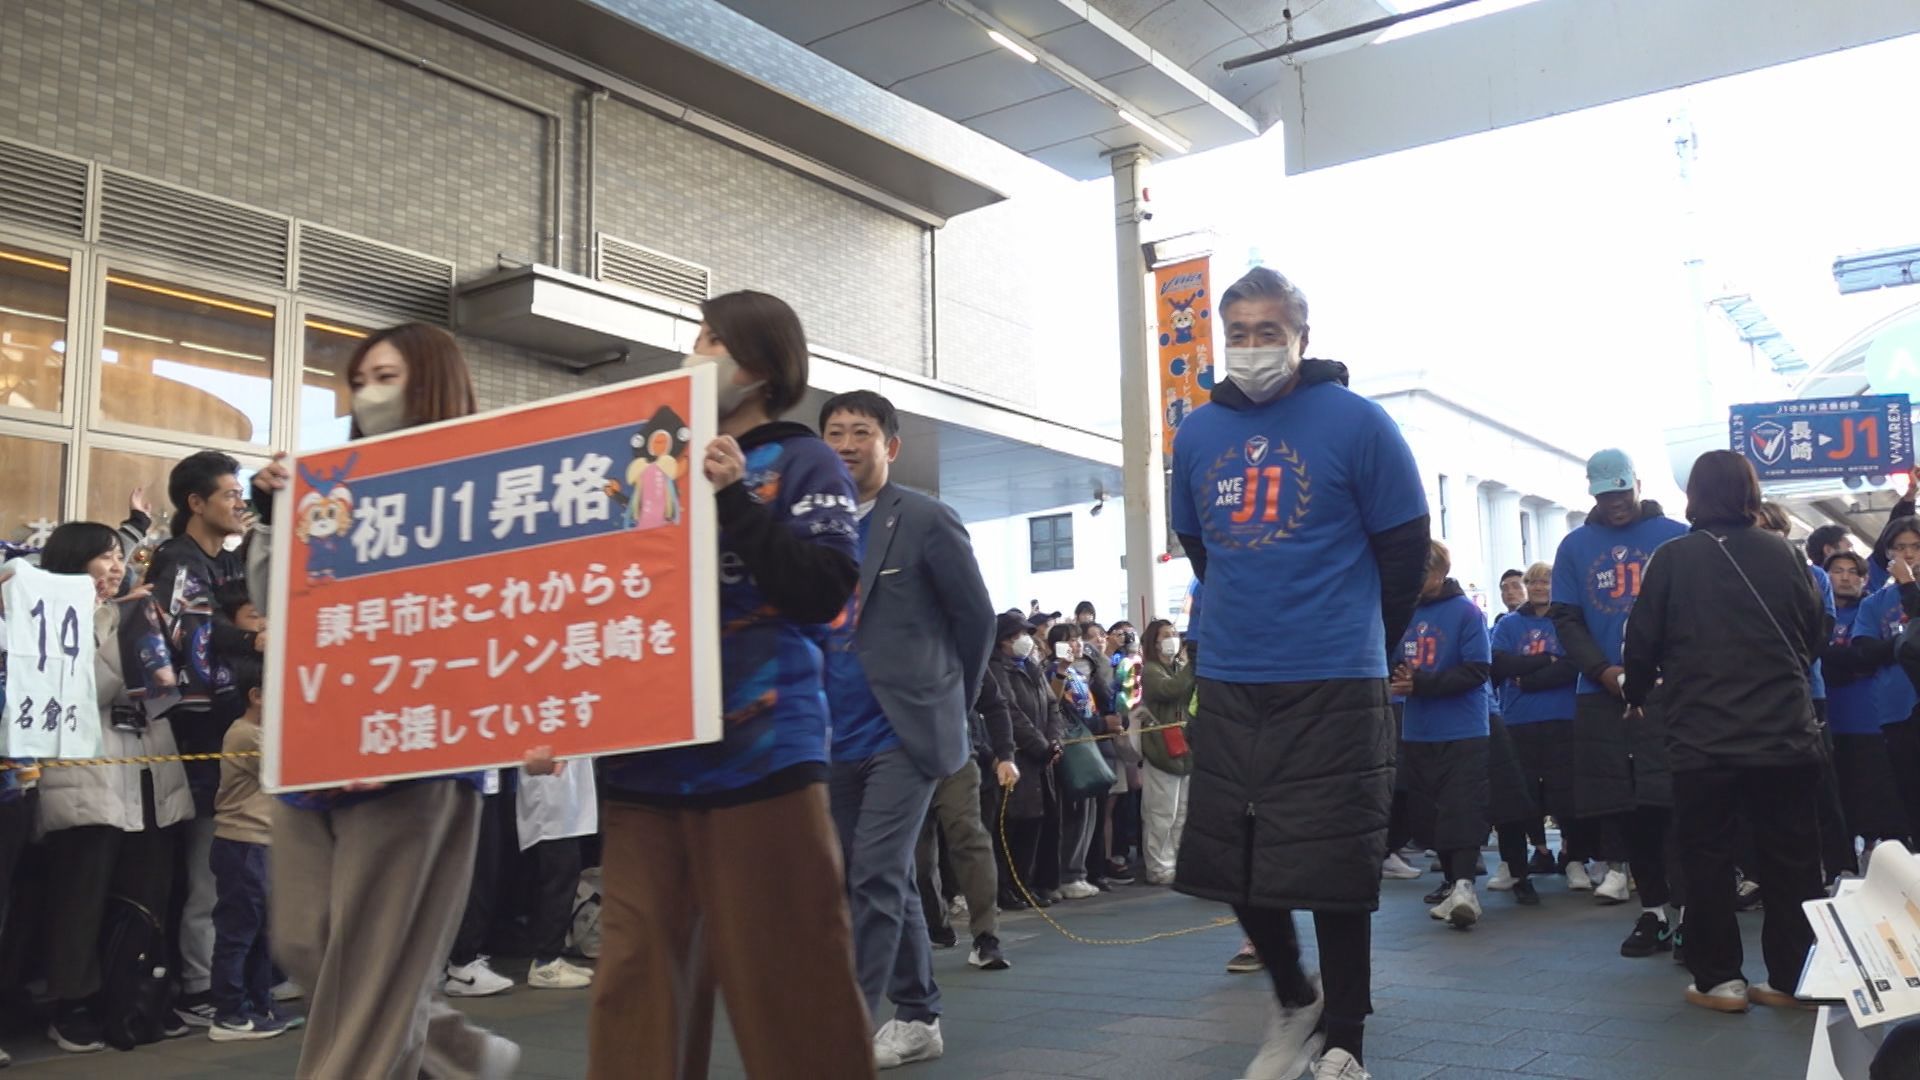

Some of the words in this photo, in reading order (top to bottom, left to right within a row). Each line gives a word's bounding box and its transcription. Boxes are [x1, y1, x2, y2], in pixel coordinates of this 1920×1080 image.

[1828, 416, 1879, 460] J1
[1215, 493, 1241, 506] ARE
[1217, 477, 1244, 494] WE
[1231, 466, 1282, 523] J1
[1610, 562, 1641, 598] J1
[359, 690, 603, 756] 応援しています
